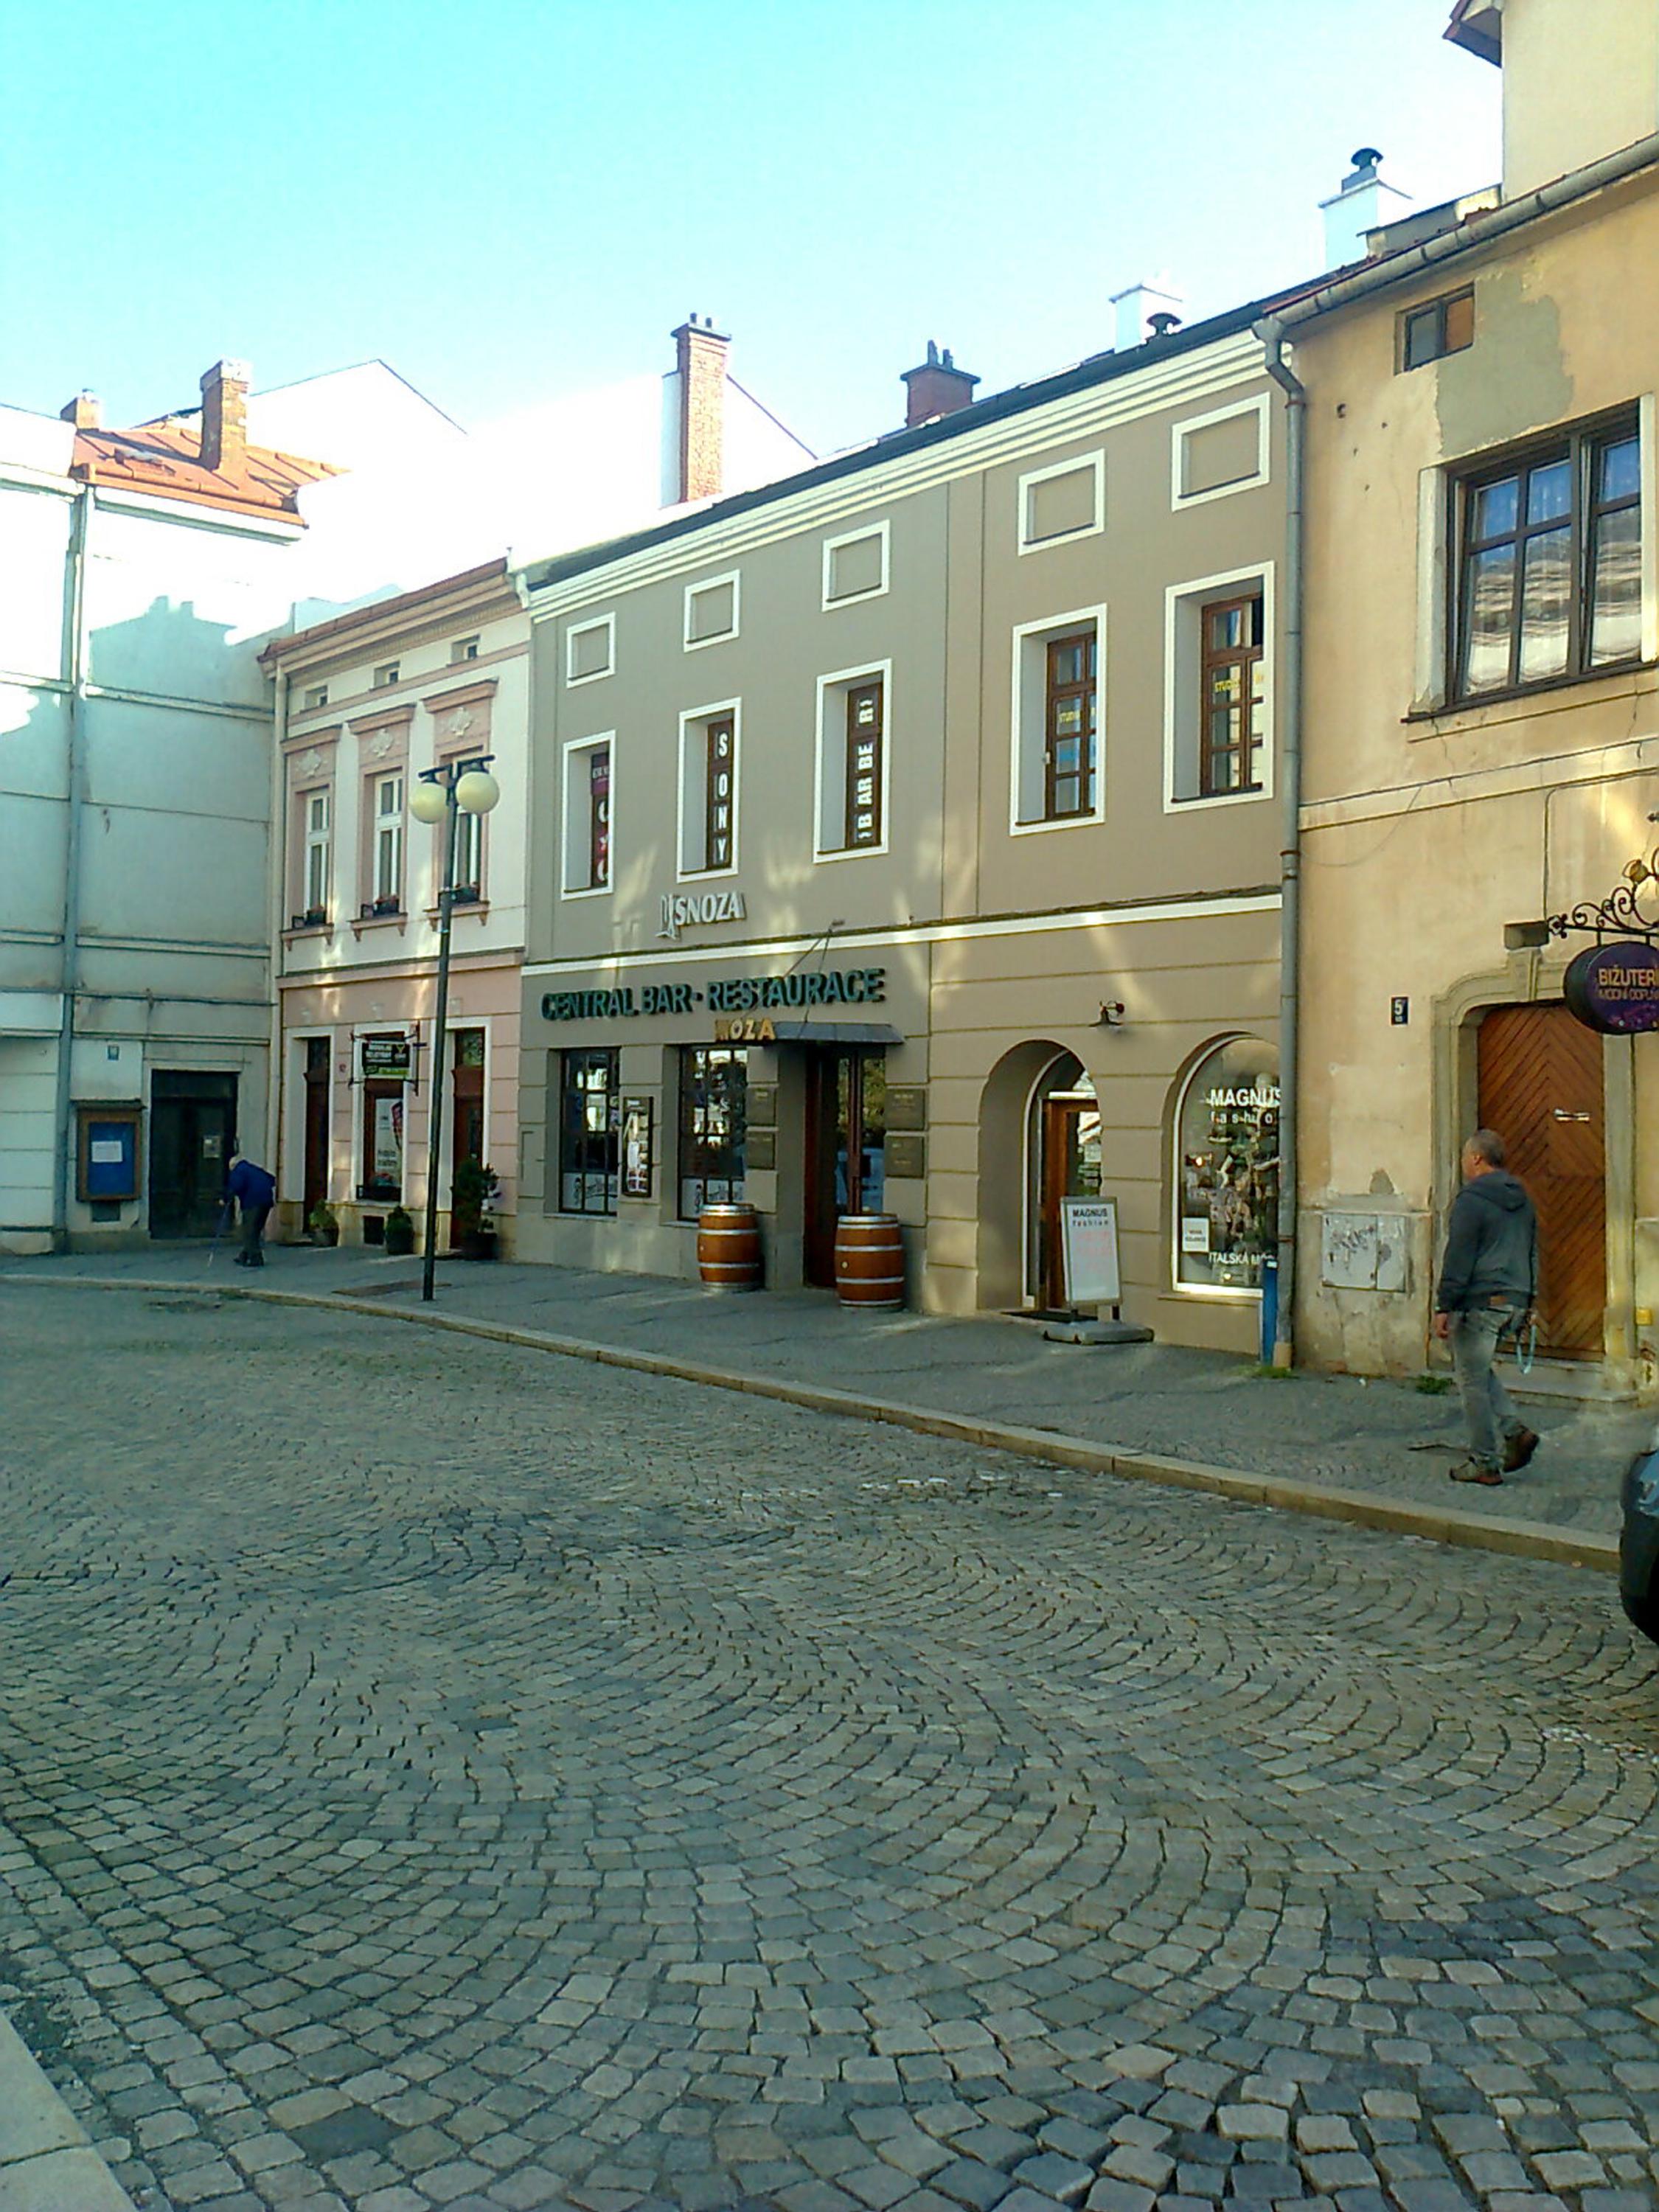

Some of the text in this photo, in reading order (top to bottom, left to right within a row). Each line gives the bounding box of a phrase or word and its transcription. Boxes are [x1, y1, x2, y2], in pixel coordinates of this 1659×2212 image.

[542, 968, 886, 1020] CENTRAL BAR RESTAURACE
[1073, 1208, 1108, 1217] MAGNUS
